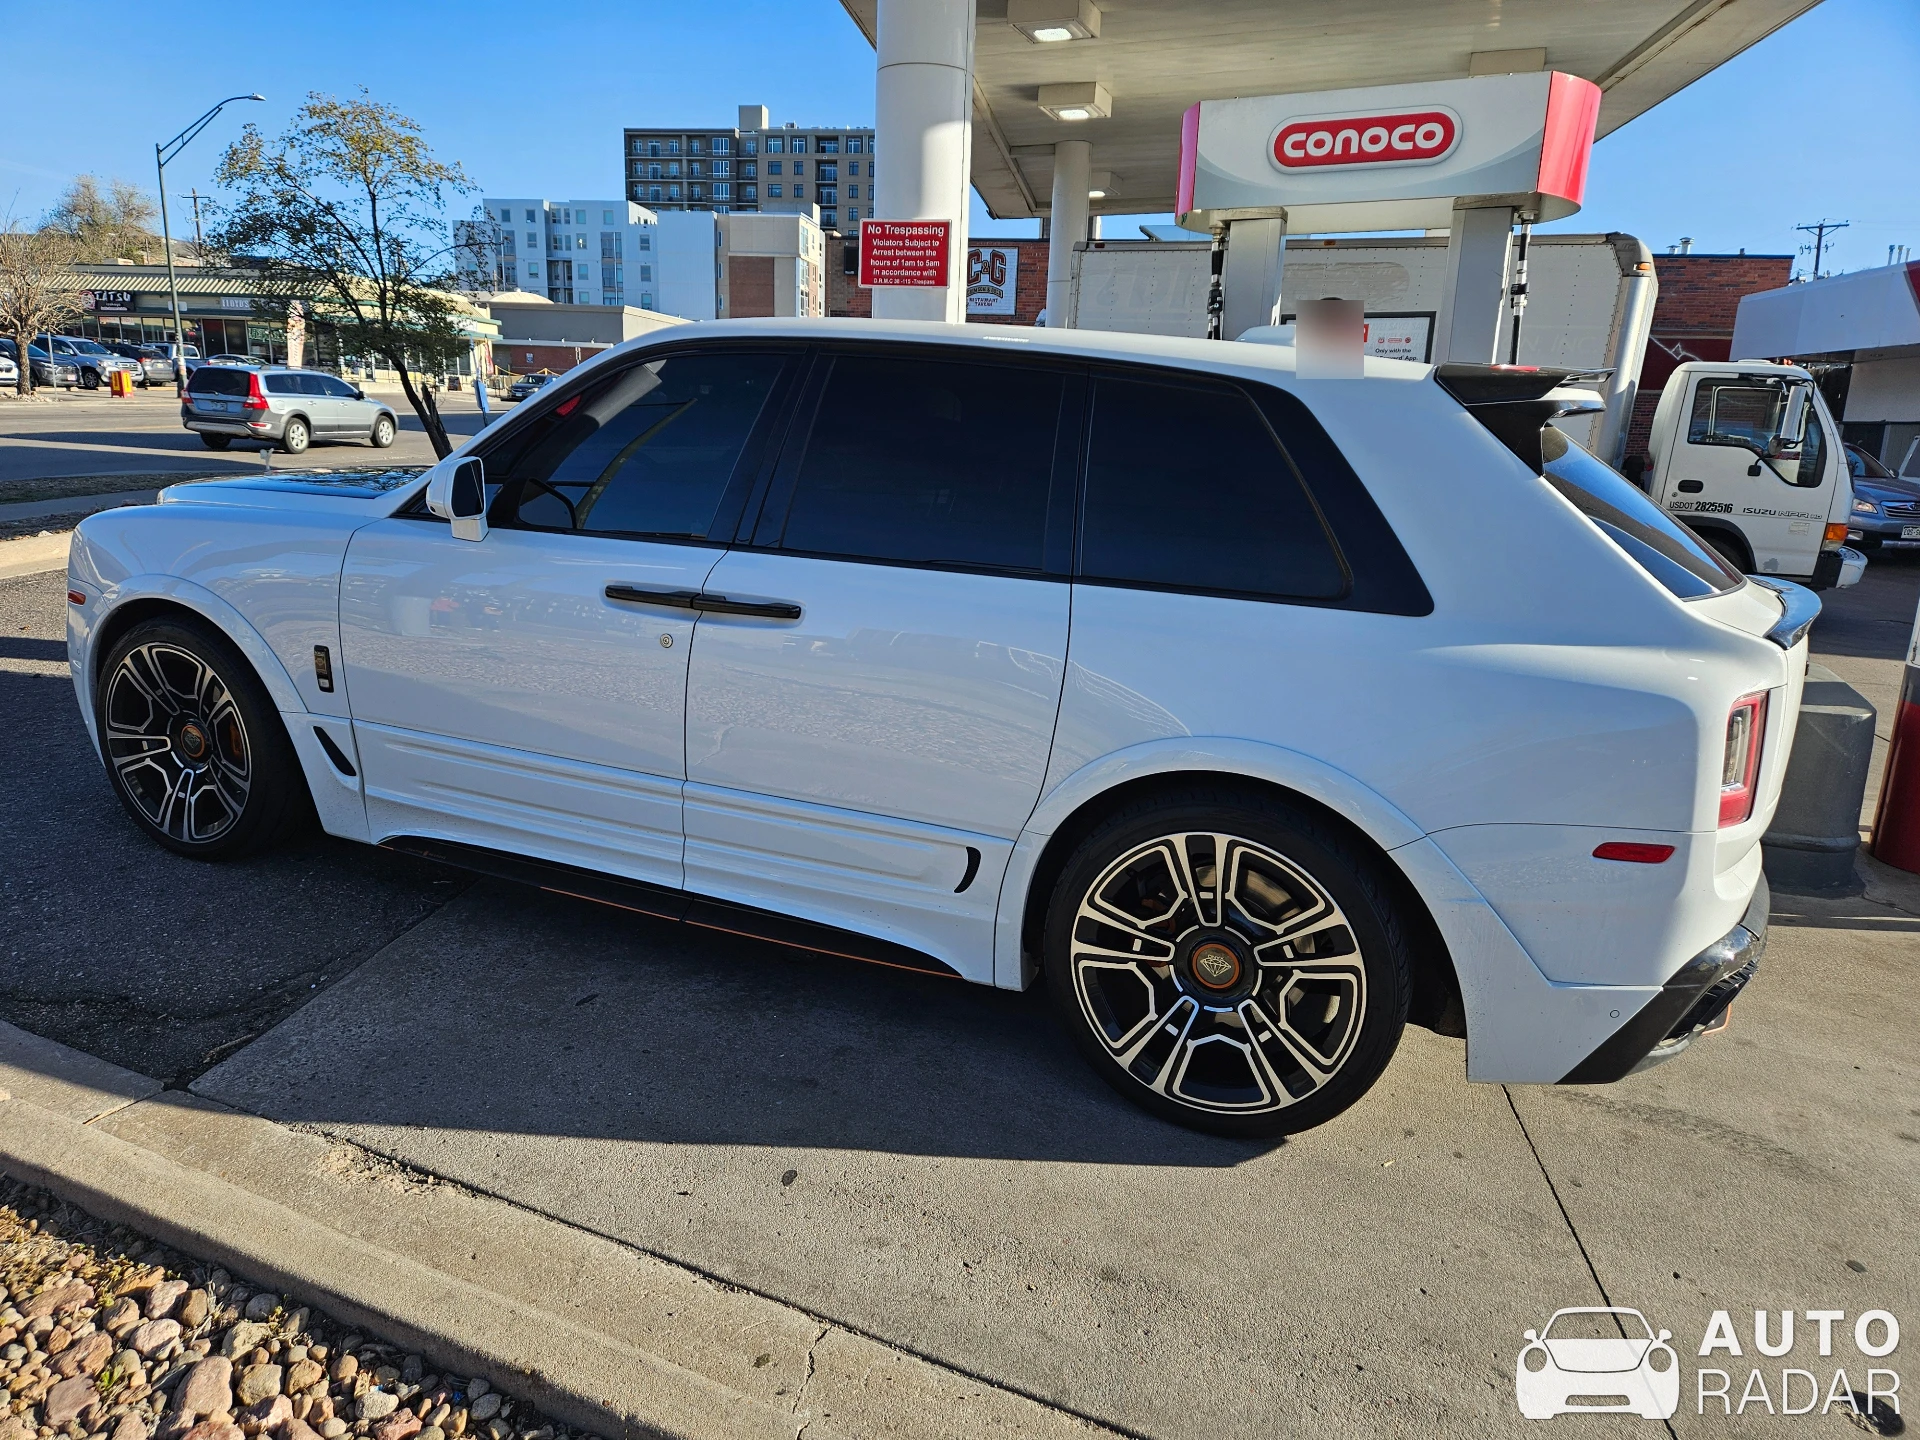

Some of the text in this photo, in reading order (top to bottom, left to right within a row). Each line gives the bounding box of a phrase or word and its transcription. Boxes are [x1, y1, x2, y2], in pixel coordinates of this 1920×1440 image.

[1283, 122, 1444, 158] CONOCO
[868, 224, 944, 237] No Trespassing
[872, 238, 903, 246] Violators
[904, 239, 931, 248] Subject
[872, 248, 894, 256] Arrest
[870, 258, 891, 266] hours
[901, 259, 915, 267] 1am
[881, 268, 921, 276] accordance
[1669, 501, 1734, 514] USDOT 2825516
[1743, 507, 1777, 516] ISUZU
